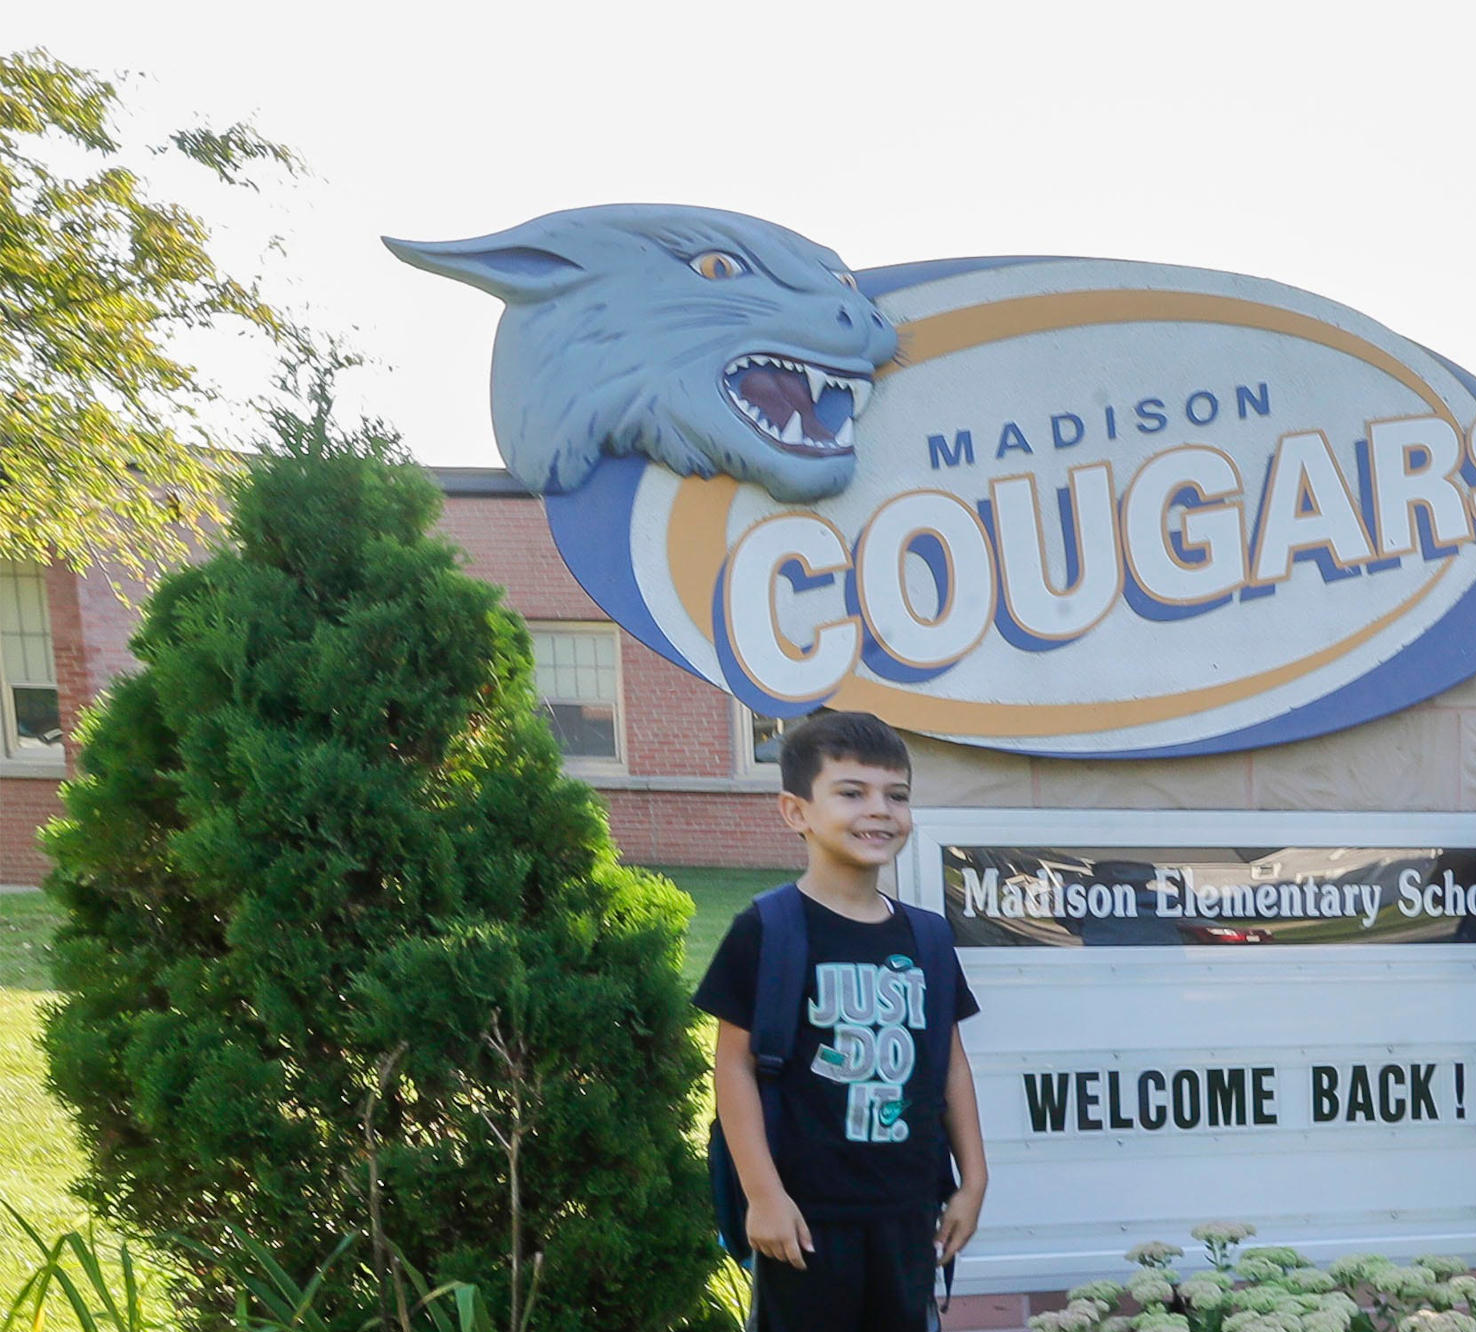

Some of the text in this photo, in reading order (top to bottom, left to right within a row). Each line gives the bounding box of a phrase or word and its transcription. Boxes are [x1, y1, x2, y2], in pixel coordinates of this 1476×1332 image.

[927, 381, 1271, 470] MADISON
[961, 867, 1138, 919] Madison
[1154, 866, 1382, 929] Elementary
[808, 961, 927, 1030] JUST
[833, 1024, 915, 1085] DO
[1023, 1066, 1279, 1133] WELCOME
